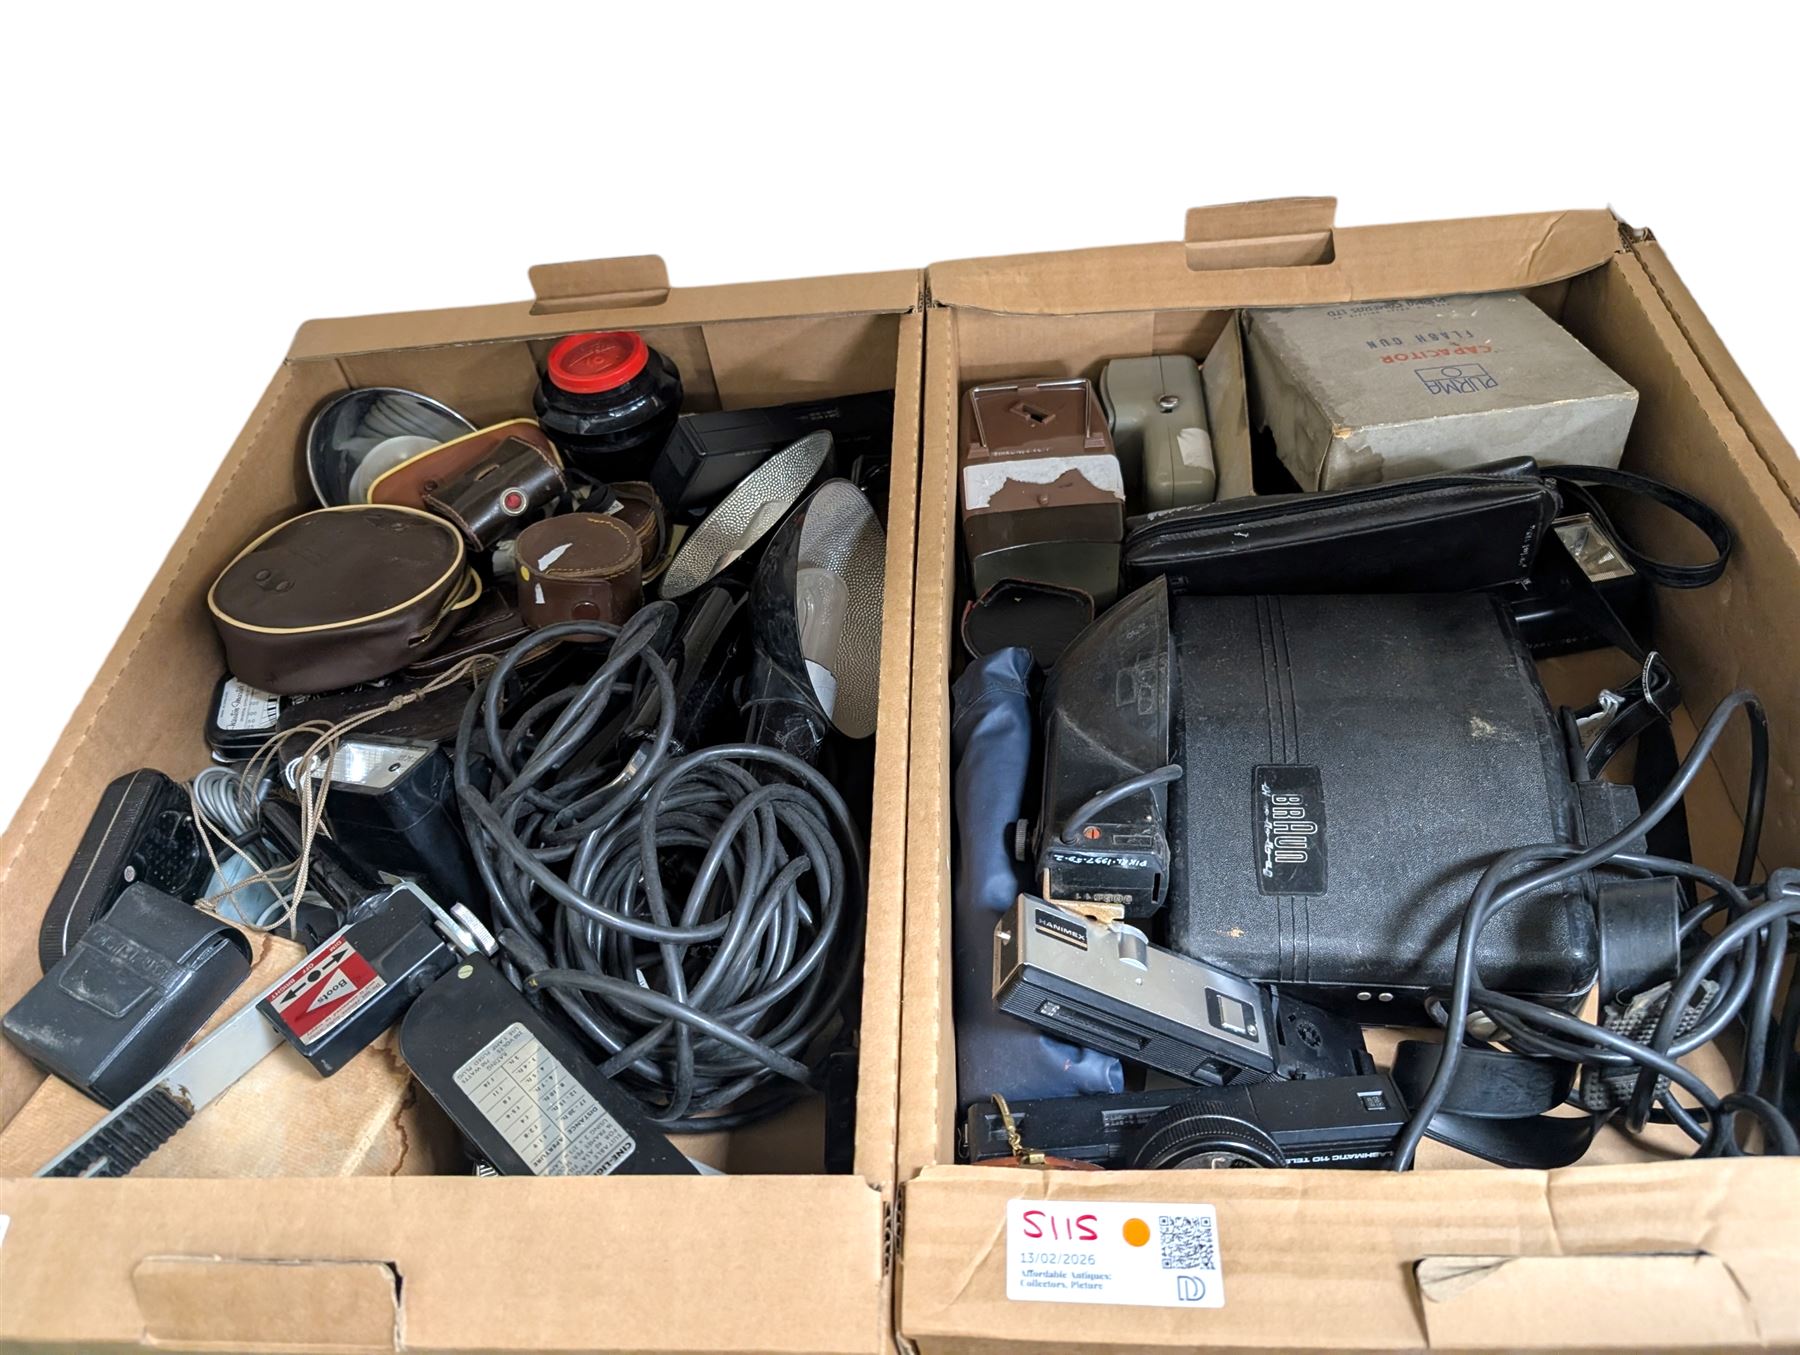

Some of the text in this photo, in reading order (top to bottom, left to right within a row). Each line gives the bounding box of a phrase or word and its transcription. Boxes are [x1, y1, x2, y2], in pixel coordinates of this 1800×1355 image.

[1365, 329, 1473, 348] FLASH GUN
[1379, 345, 1492, 363] CAPACITOR
[1422, 374, 1497, 394] PURMA
[1271, 793, 1317, 862] BRAUN
[1039, 918, 1085, 940] HANIMEX
[270, 939, 342, 999] DIM OFF BRIGHT
[316, 978, 347, 1005] Boots
[496, 1037, 513, 1054] VOLTS
[485, 1050, 507, 1071] RATING
[456, 1065, 472, 1080] PLUG
[460, 1065, 480, 1084] WATTS
[532, 1105, 598, 1167] DISTANCE APERTURE
[1331, 1150, 1394, 1160] LASHMATIC
[573, 1159, 592, 1177] EXPO
[1020, 1252, 1096, 1265] 13/02/2026
[1022, 1269, 1067, 1279] Affordable
